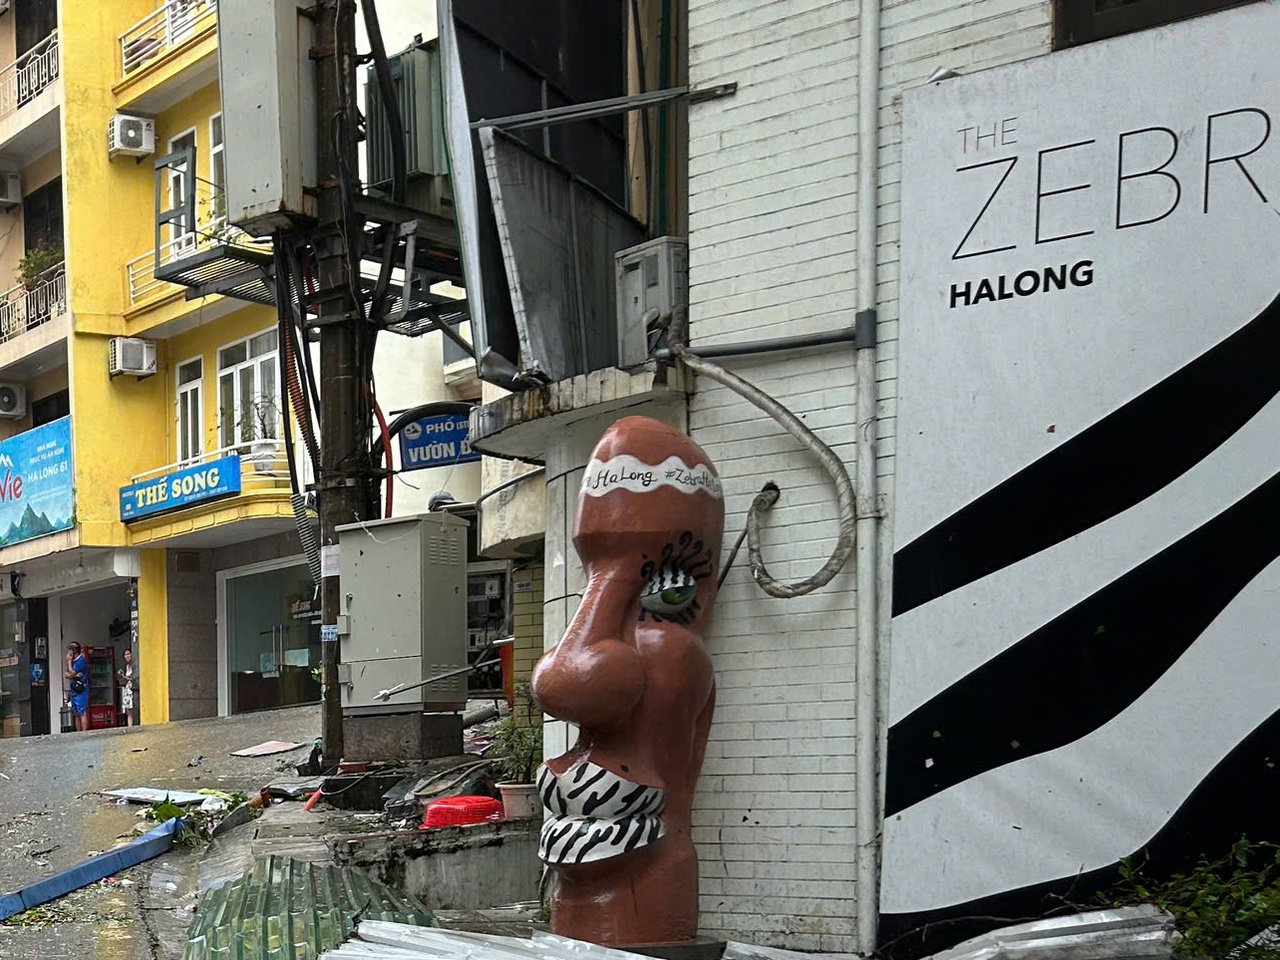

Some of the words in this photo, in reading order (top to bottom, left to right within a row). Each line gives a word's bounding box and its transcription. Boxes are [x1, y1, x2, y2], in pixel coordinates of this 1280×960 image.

[956, 116, 1018, 154] THE
[949, 260, 1095, 309] HALONG
[425, 416, 455, 434] PHỐ
[408, 441, 456, 463] VƯỜN
[39, 463, 59, 480] LONG
[60, 460, 68, 472] 61
[171, 468, 220, 498] SONG
